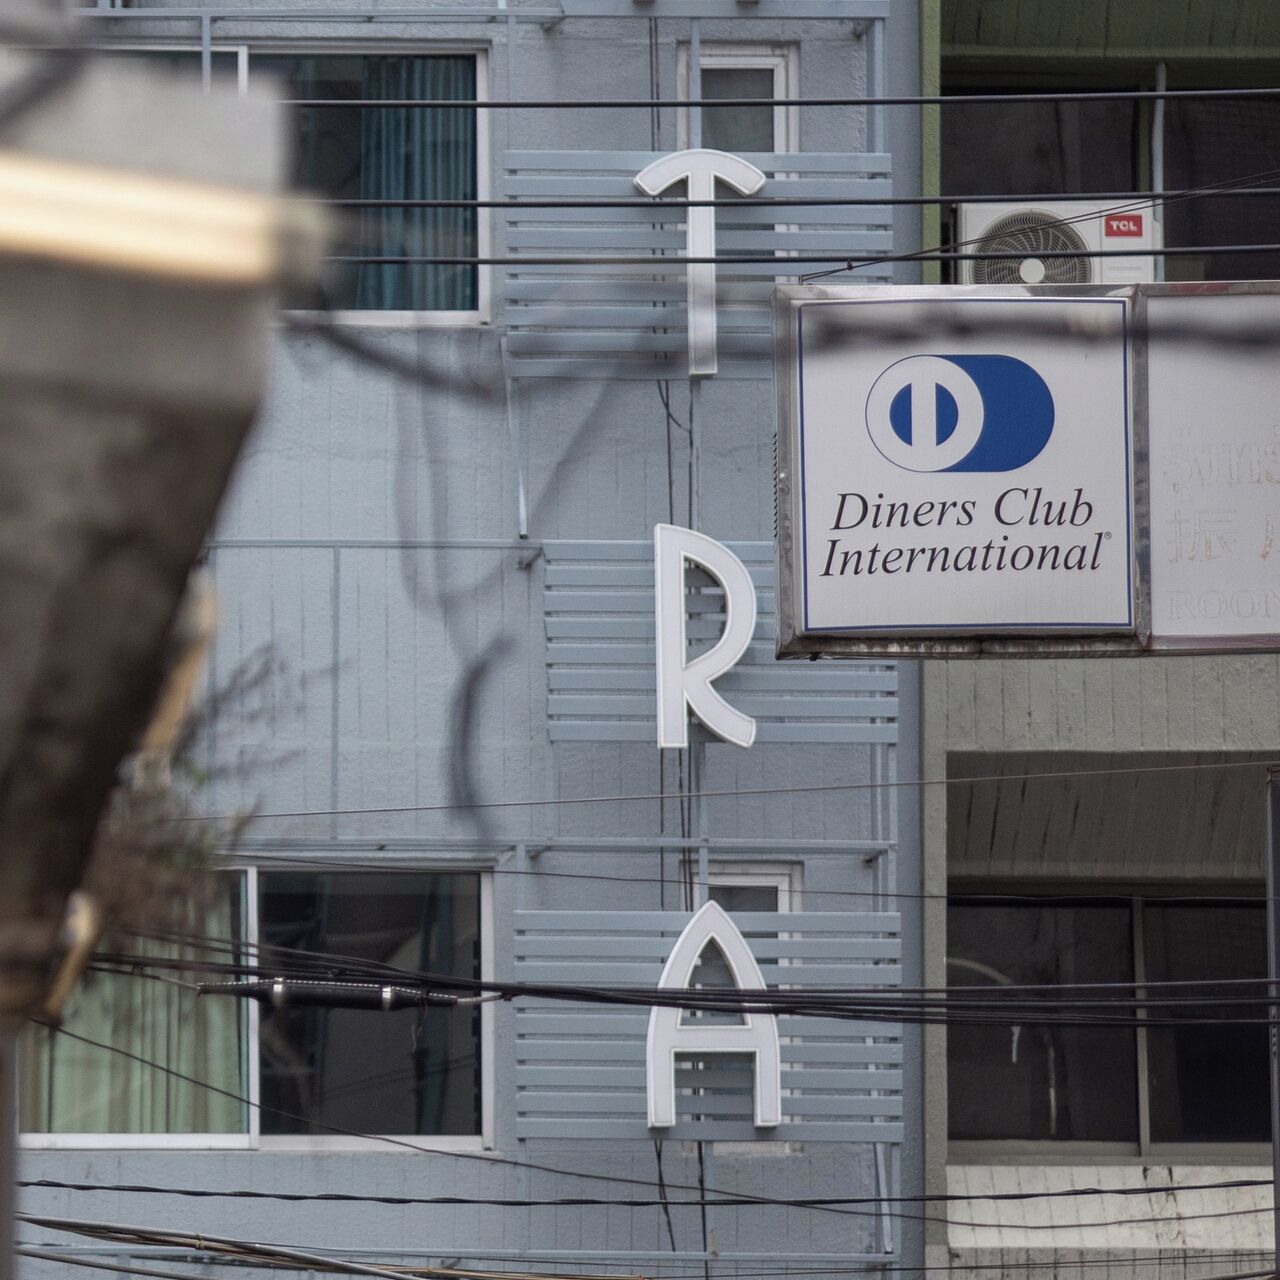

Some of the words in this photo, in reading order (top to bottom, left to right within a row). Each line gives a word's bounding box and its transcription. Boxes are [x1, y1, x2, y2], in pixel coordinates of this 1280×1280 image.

[1108, 219, 1138, 233] TCL
[829, 492, 976, 531] Diners
[993, 487, 1094, 526] Club
